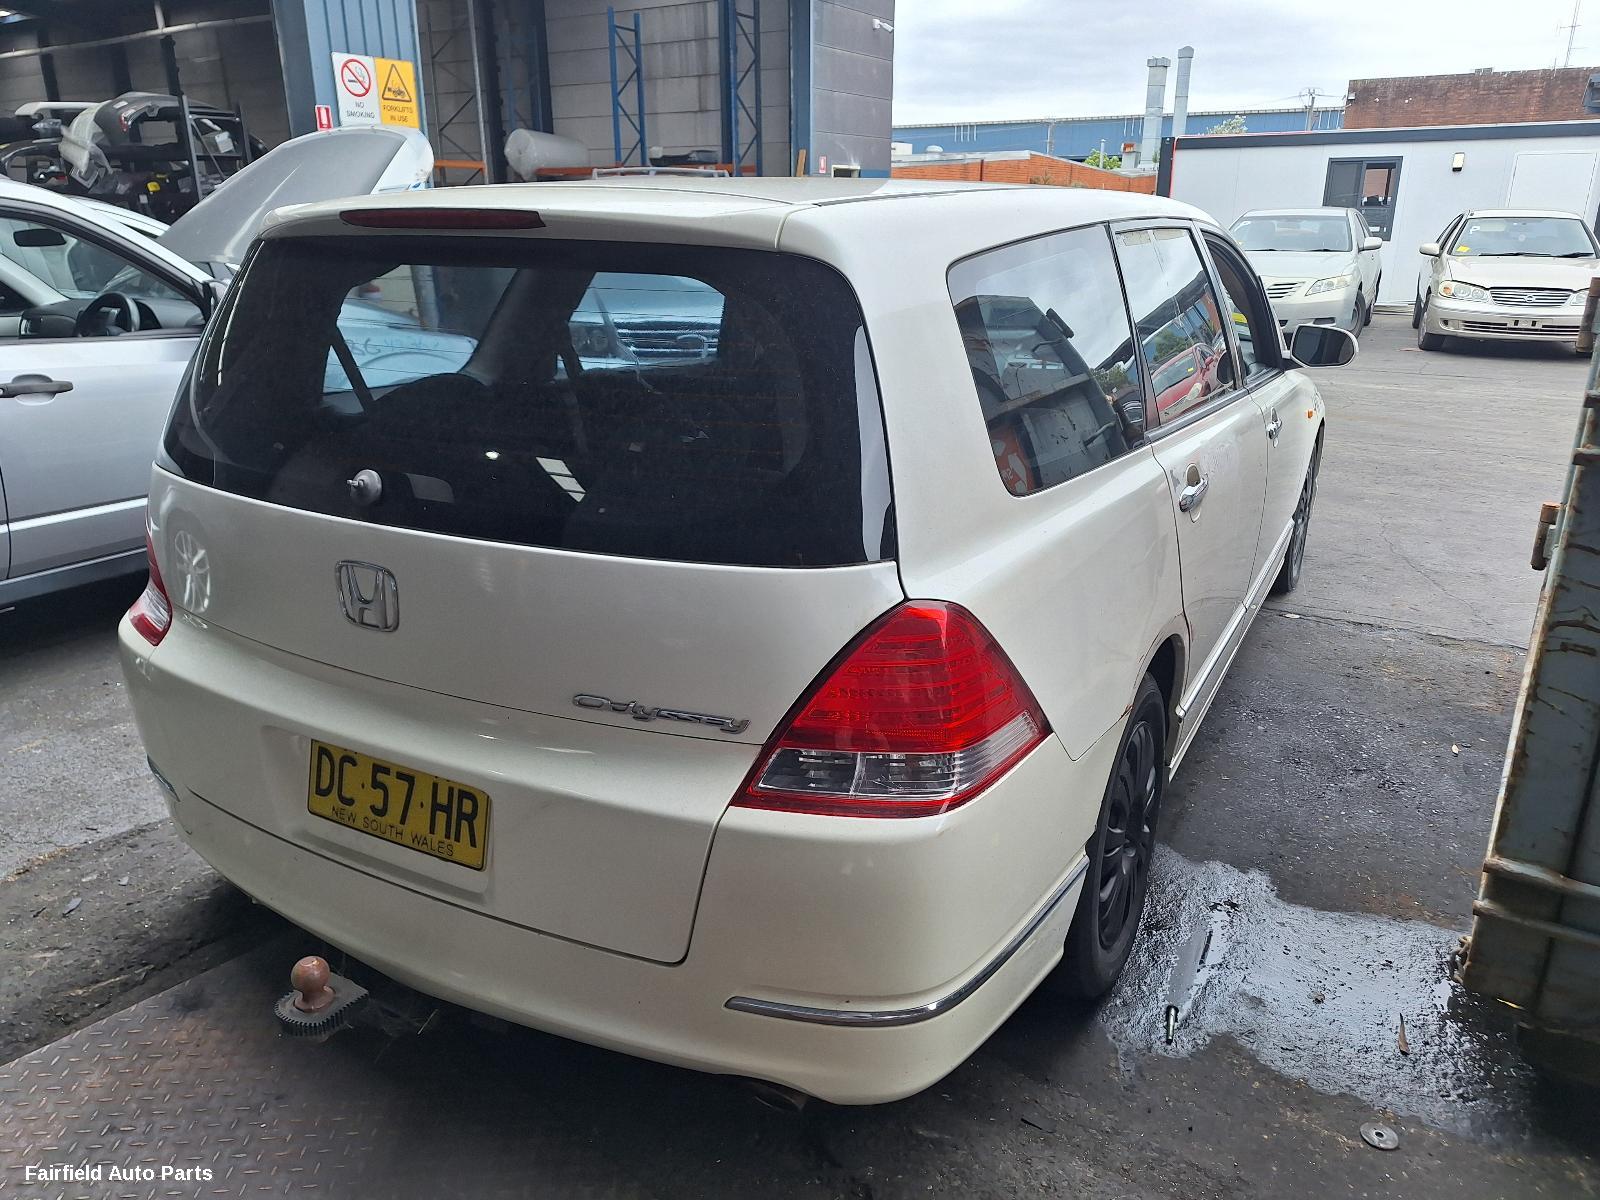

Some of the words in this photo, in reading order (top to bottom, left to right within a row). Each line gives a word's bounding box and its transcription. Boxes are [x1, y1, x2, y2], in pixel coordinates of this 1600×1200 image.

[383, 105, 414, 114] FORKLIFTS
[346, 111, 376, 119] SMOKING
[398, 115, 409, 123] USE
[573, 694, 750, 734] Odyssey
[331, 806, 357, 825] NEW
[363, 816, 404, 841] SOUTH
[411, 831, 454, 857] WALES
